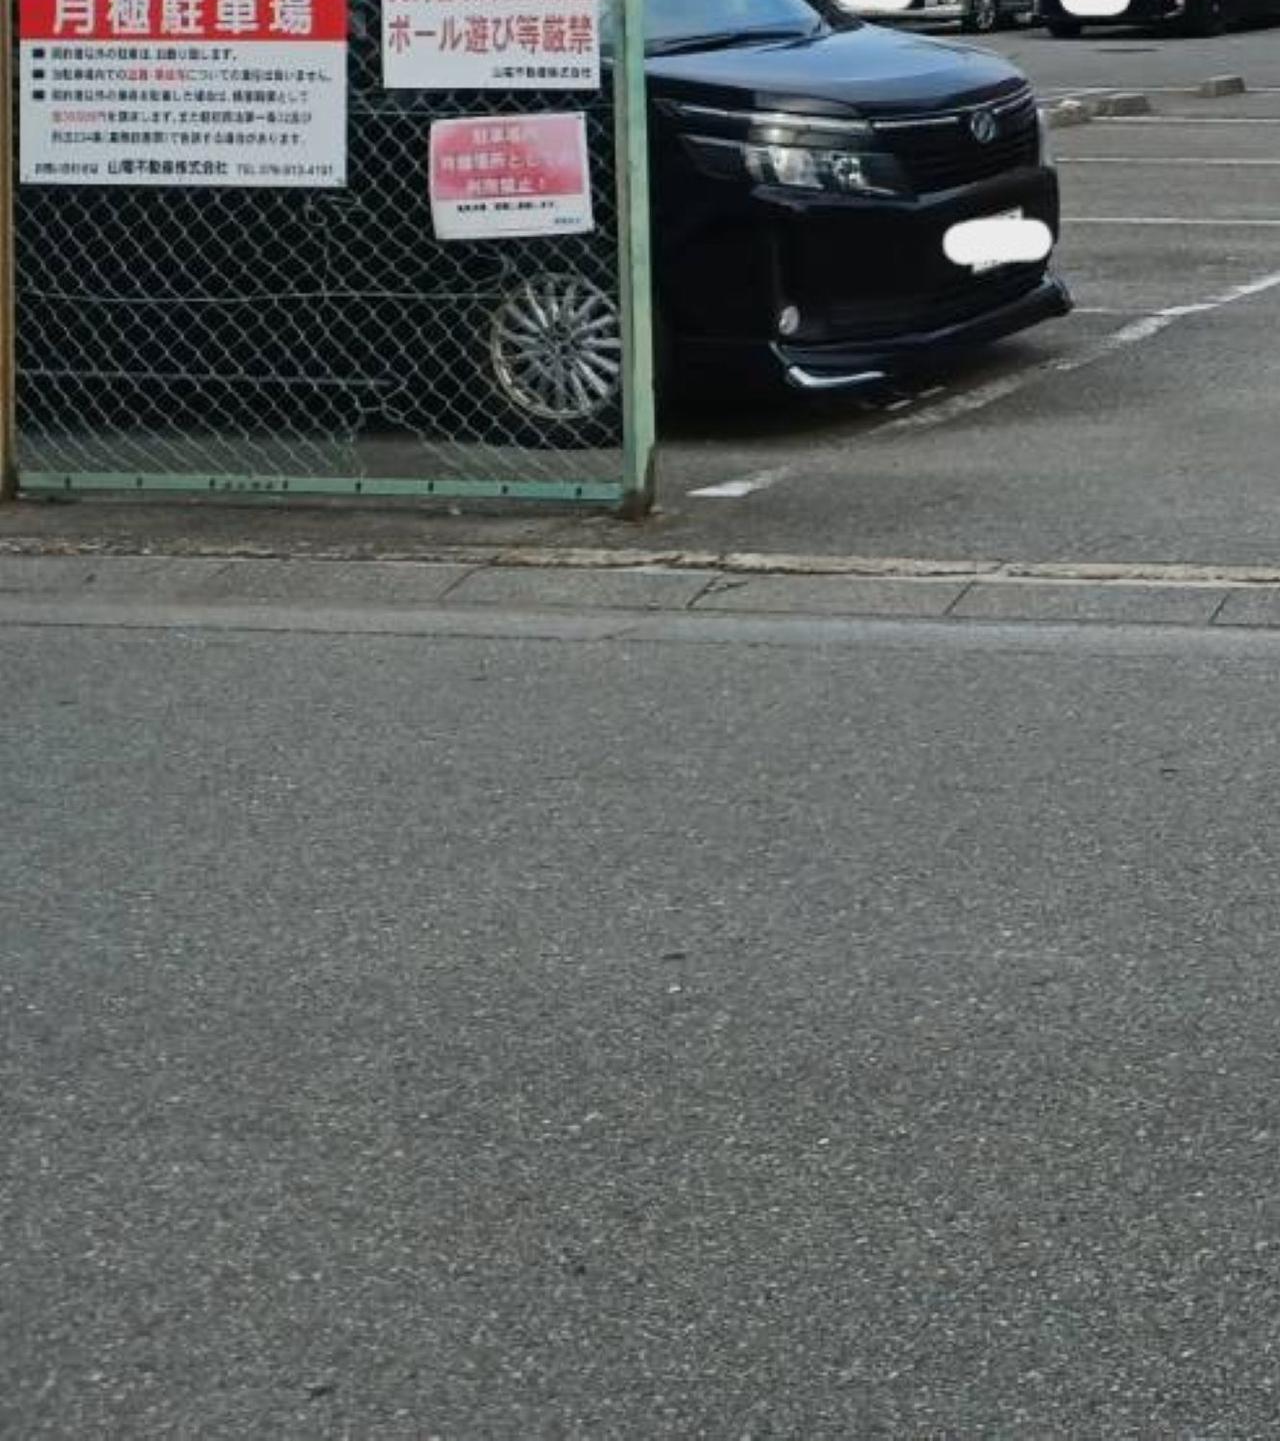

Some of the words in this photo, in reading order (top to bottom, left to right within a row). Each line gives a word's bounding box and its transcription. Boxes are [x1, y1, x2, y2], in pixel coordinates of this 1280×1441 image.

[388, 14, 594, 56] ボール遊び等厳禁
